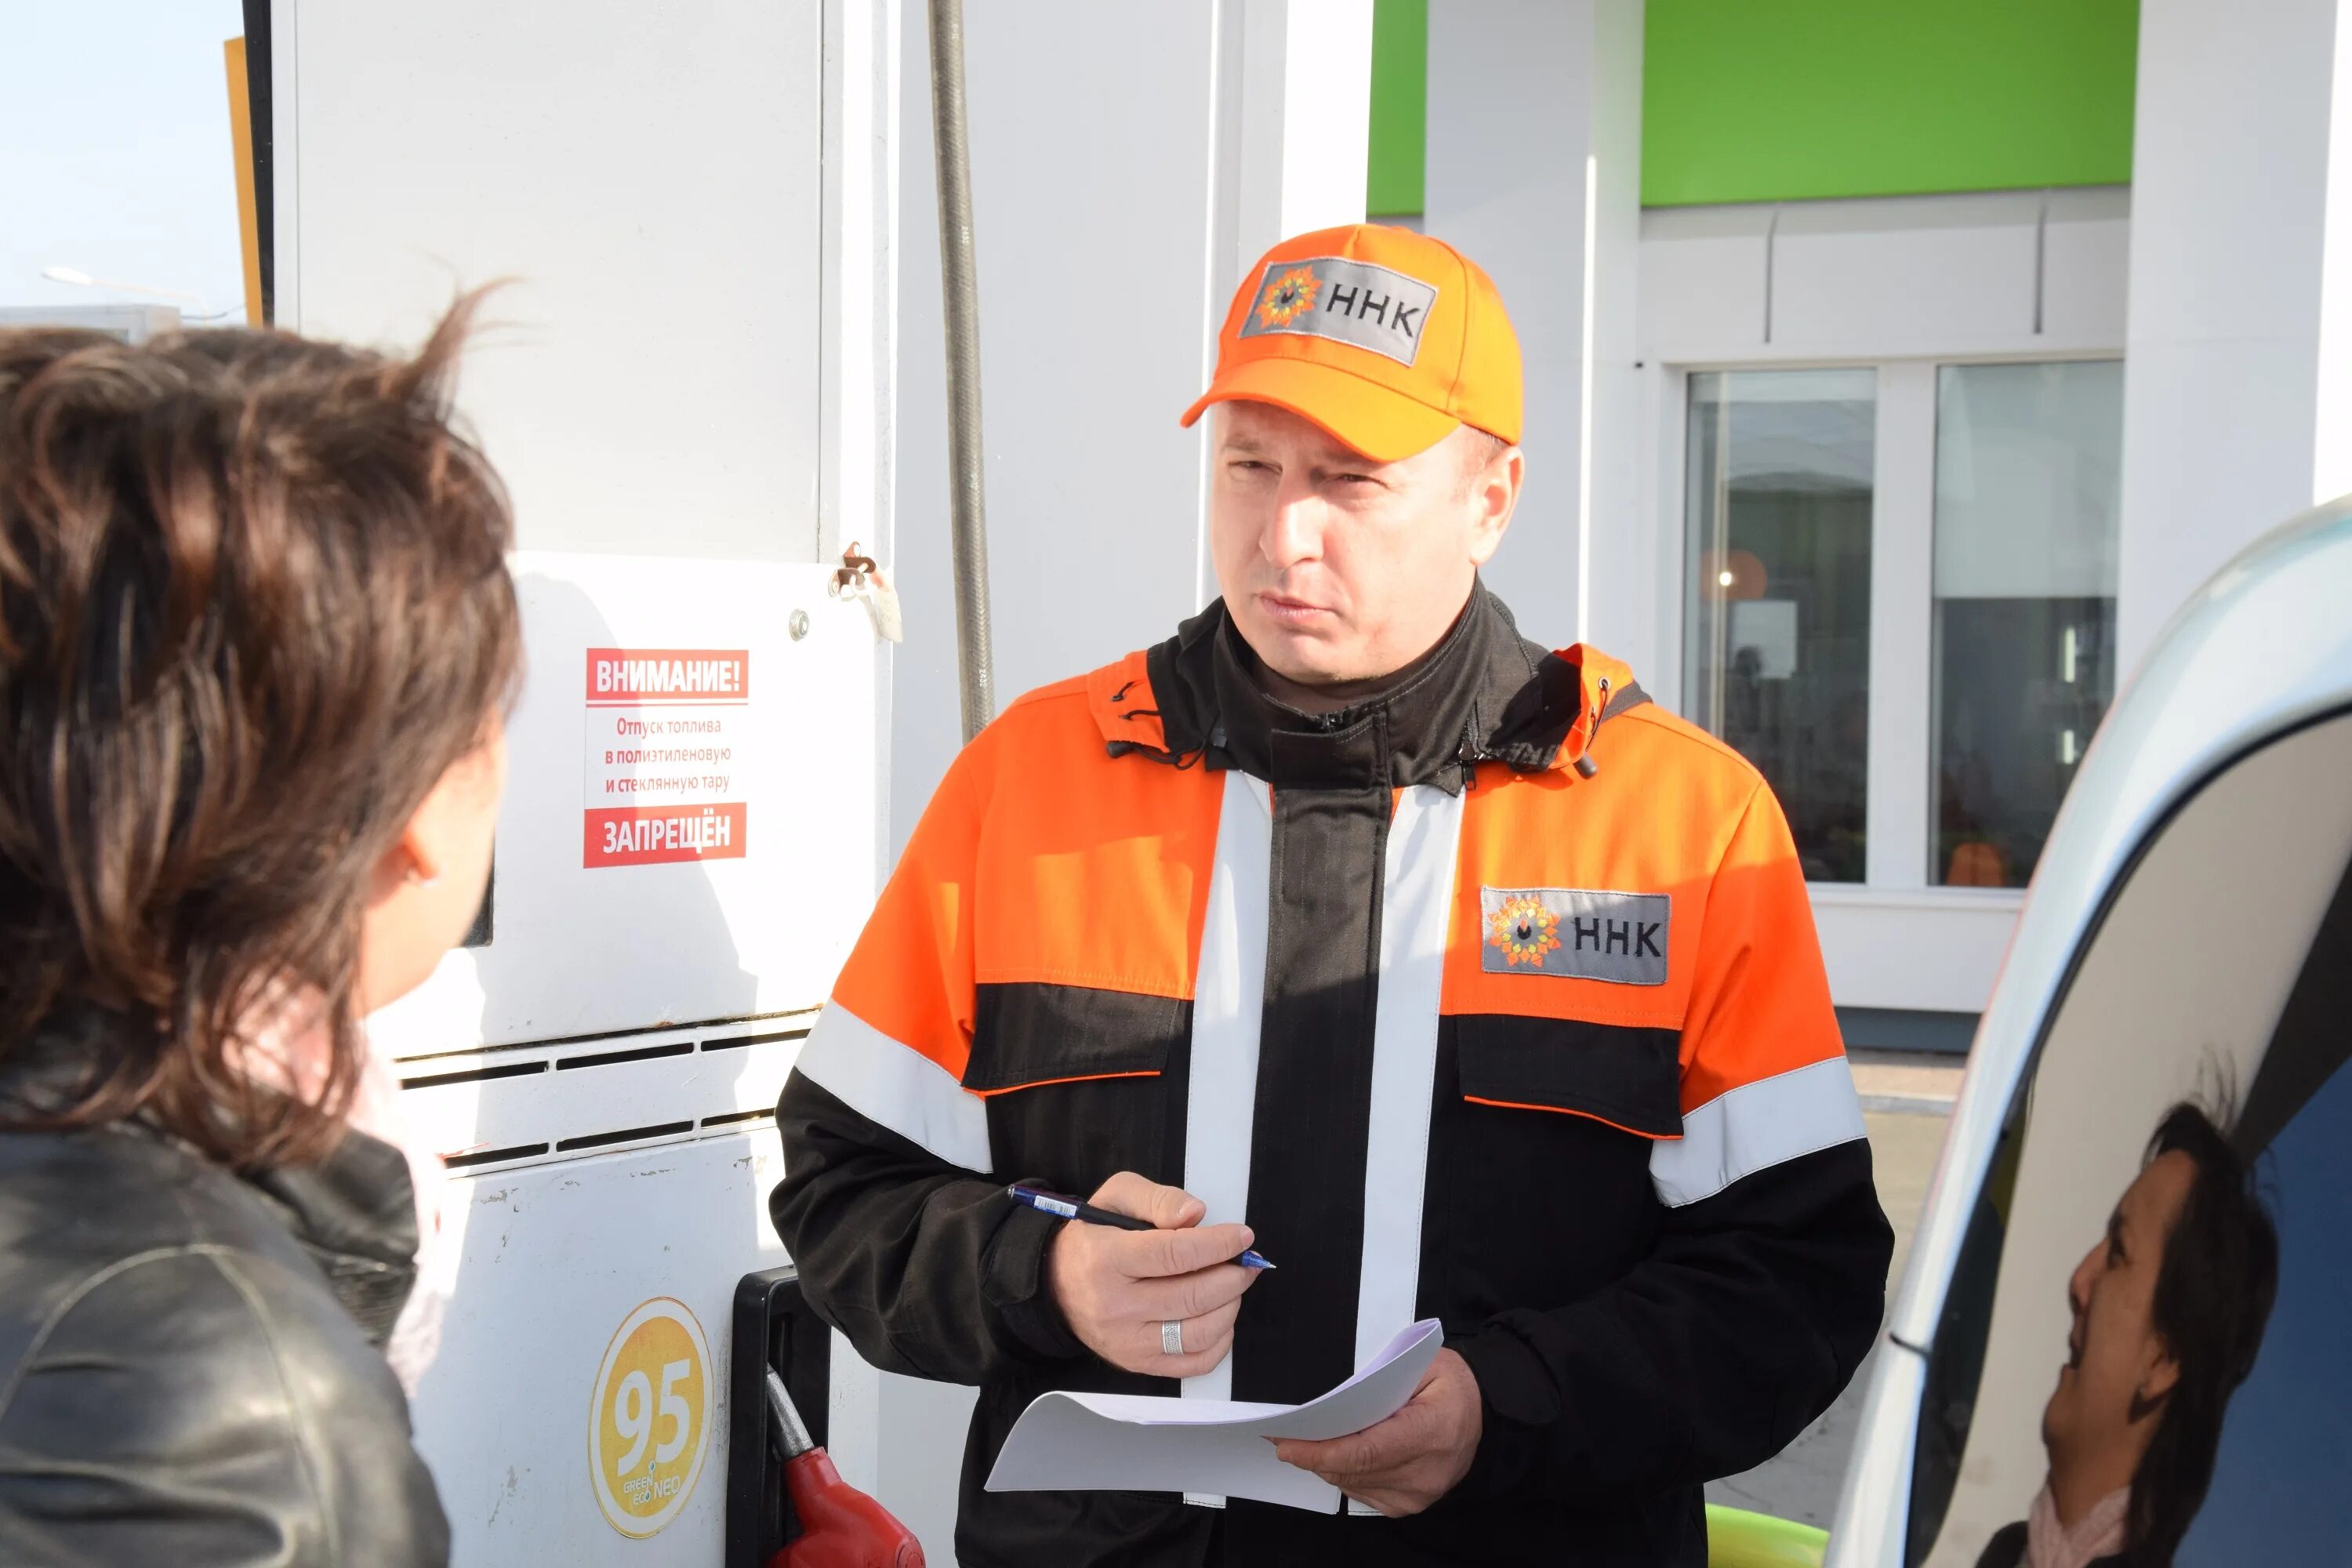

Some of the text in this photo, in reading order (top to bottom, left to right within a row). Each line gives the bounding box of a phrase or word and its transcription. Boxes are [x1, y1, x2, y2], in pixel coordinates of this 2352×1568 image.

[1325, 283, 1420, 337] ННК
[597, 659, 740, 692] ВНИМАНИЕ!
[616, 717, 721, 739] Отпуск топлива
[605, 746, 731, 766] в полиэтиленовую
[605, 774, 730, 794] и стеклянную тару
[603, 808, 731, 854] ЗАПРЕЩЁН
[1574, 916, 1662, 958] ННК
[615, 1358, 691, 1477] 95
[624, 1474, 653, 1494] GREEN
[654, 1475, 681, 1499] NEO
